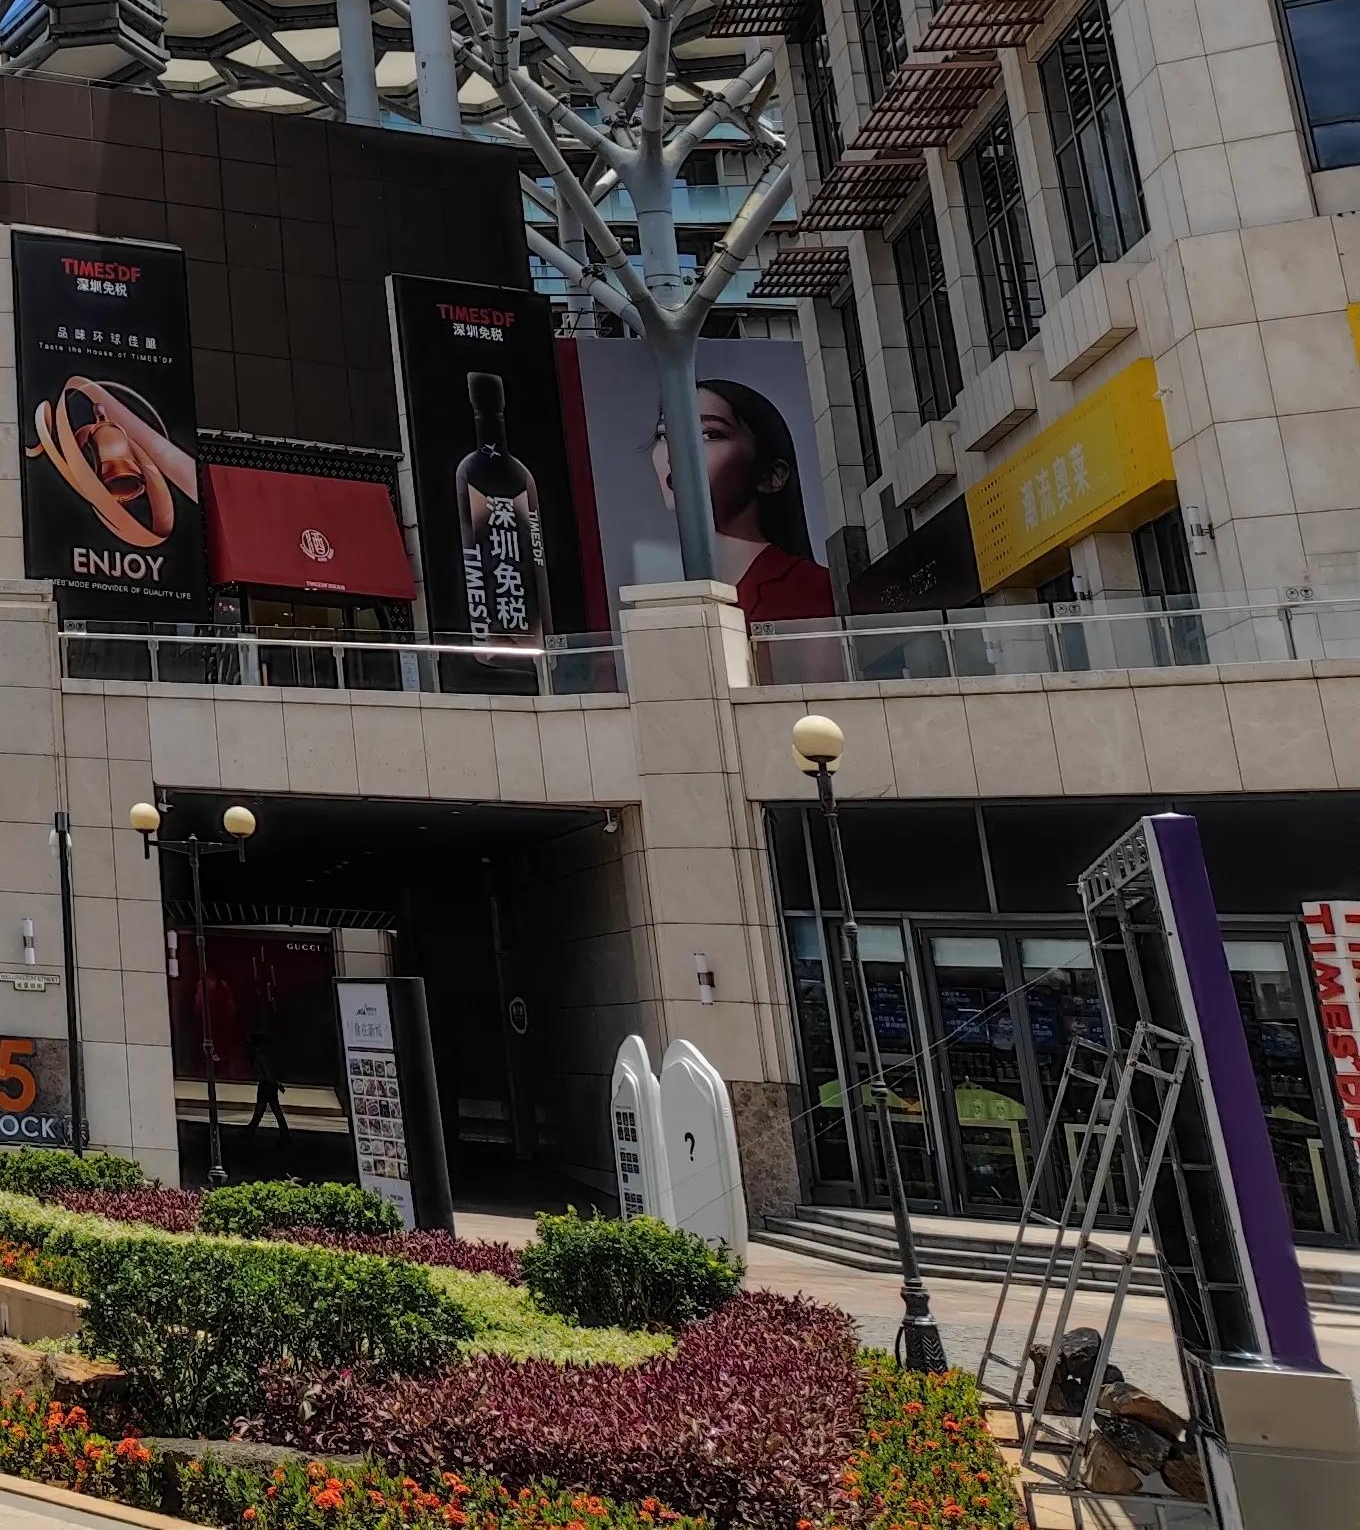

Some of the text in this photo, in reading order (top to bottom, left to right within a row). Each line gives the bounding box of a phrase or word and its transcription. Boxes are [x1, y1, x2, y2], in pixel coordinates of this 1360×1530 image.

[76, 278, 128, 298] 深圳免税
[453, 322, 504, 342] 深圳免税
[73, 548, 164, 582] ENJOY
[486, 495, 529, 631] 深圳免税
[92, 582, 129, 593] PROVIDER
[143, 588, 174, 598] QUALITY
[176, 591, 191, 599] LIFE
[286, 943, 321, 952] GUCCI
